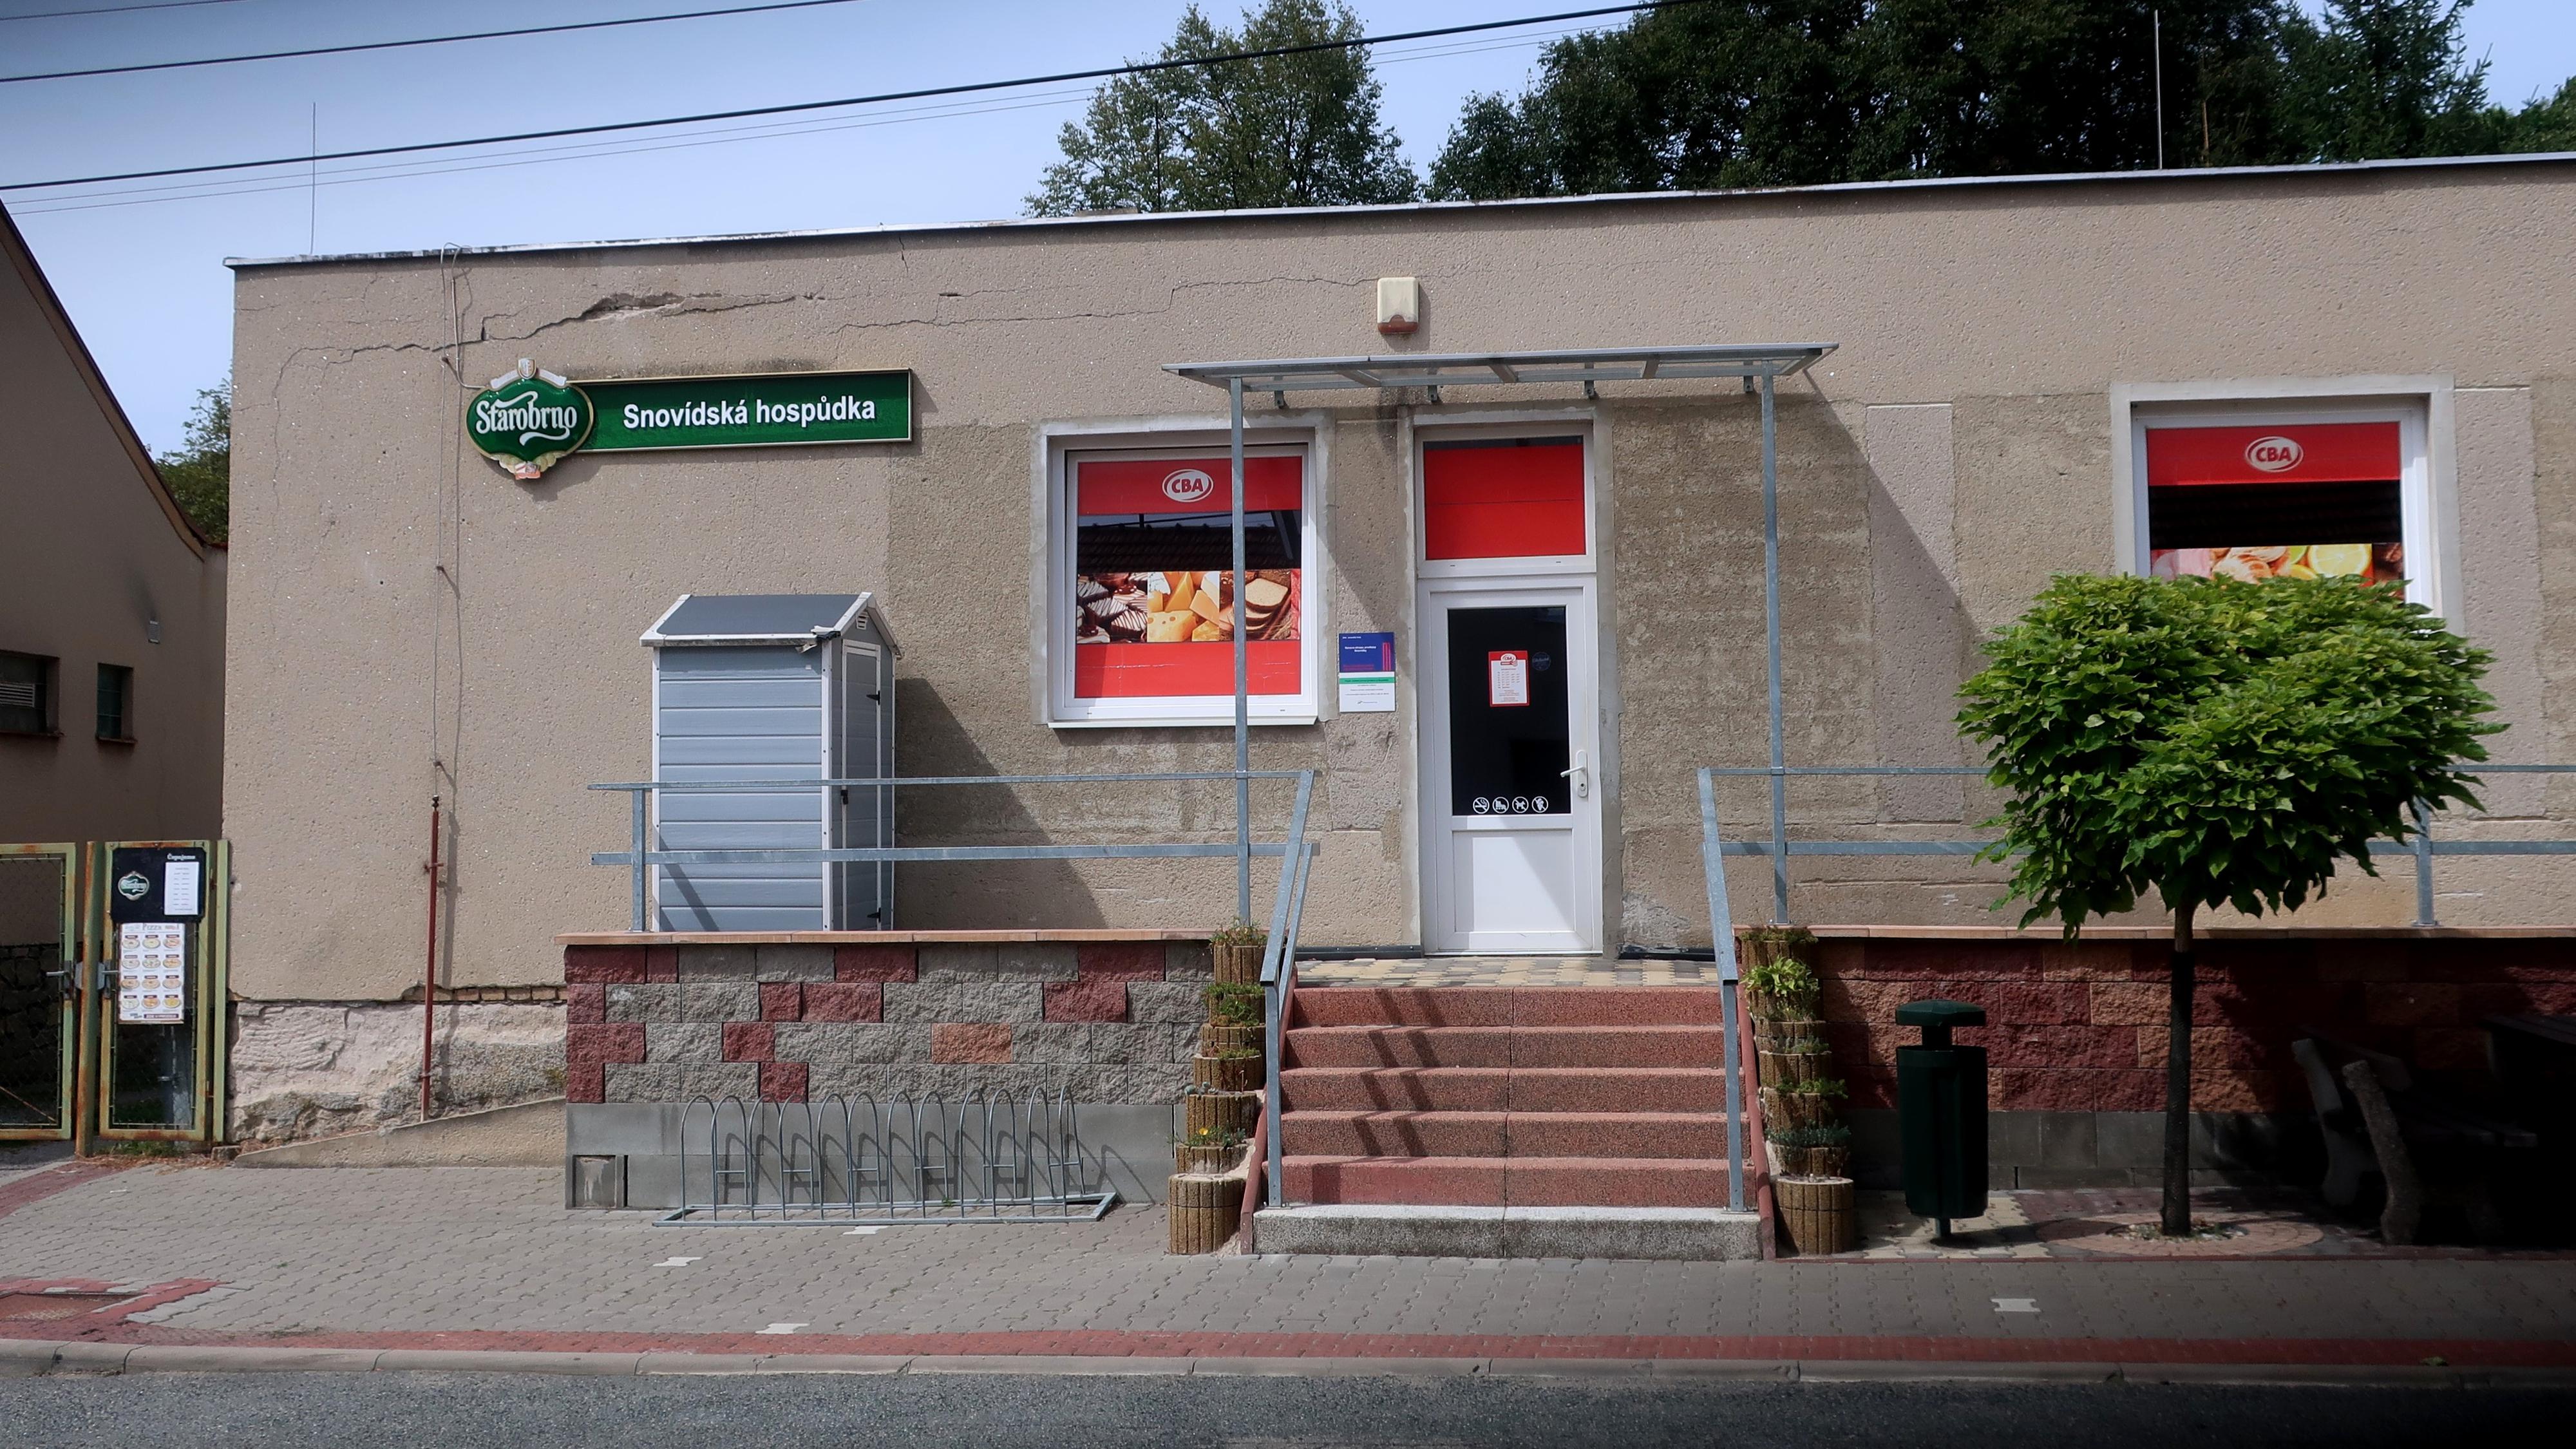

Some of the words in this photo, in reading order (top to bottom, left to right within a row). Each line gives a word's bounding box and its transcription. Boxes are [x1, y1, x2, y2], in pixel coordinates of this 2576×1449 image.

[476, 391, 578, 446] Starobrno
[623, 399, 748, 429] Snovídská
[756, 395, 876, 428] hospůdka
[2256, 447, 2292, 462] CBA
[1171, 478, 1204, 493] CBA
